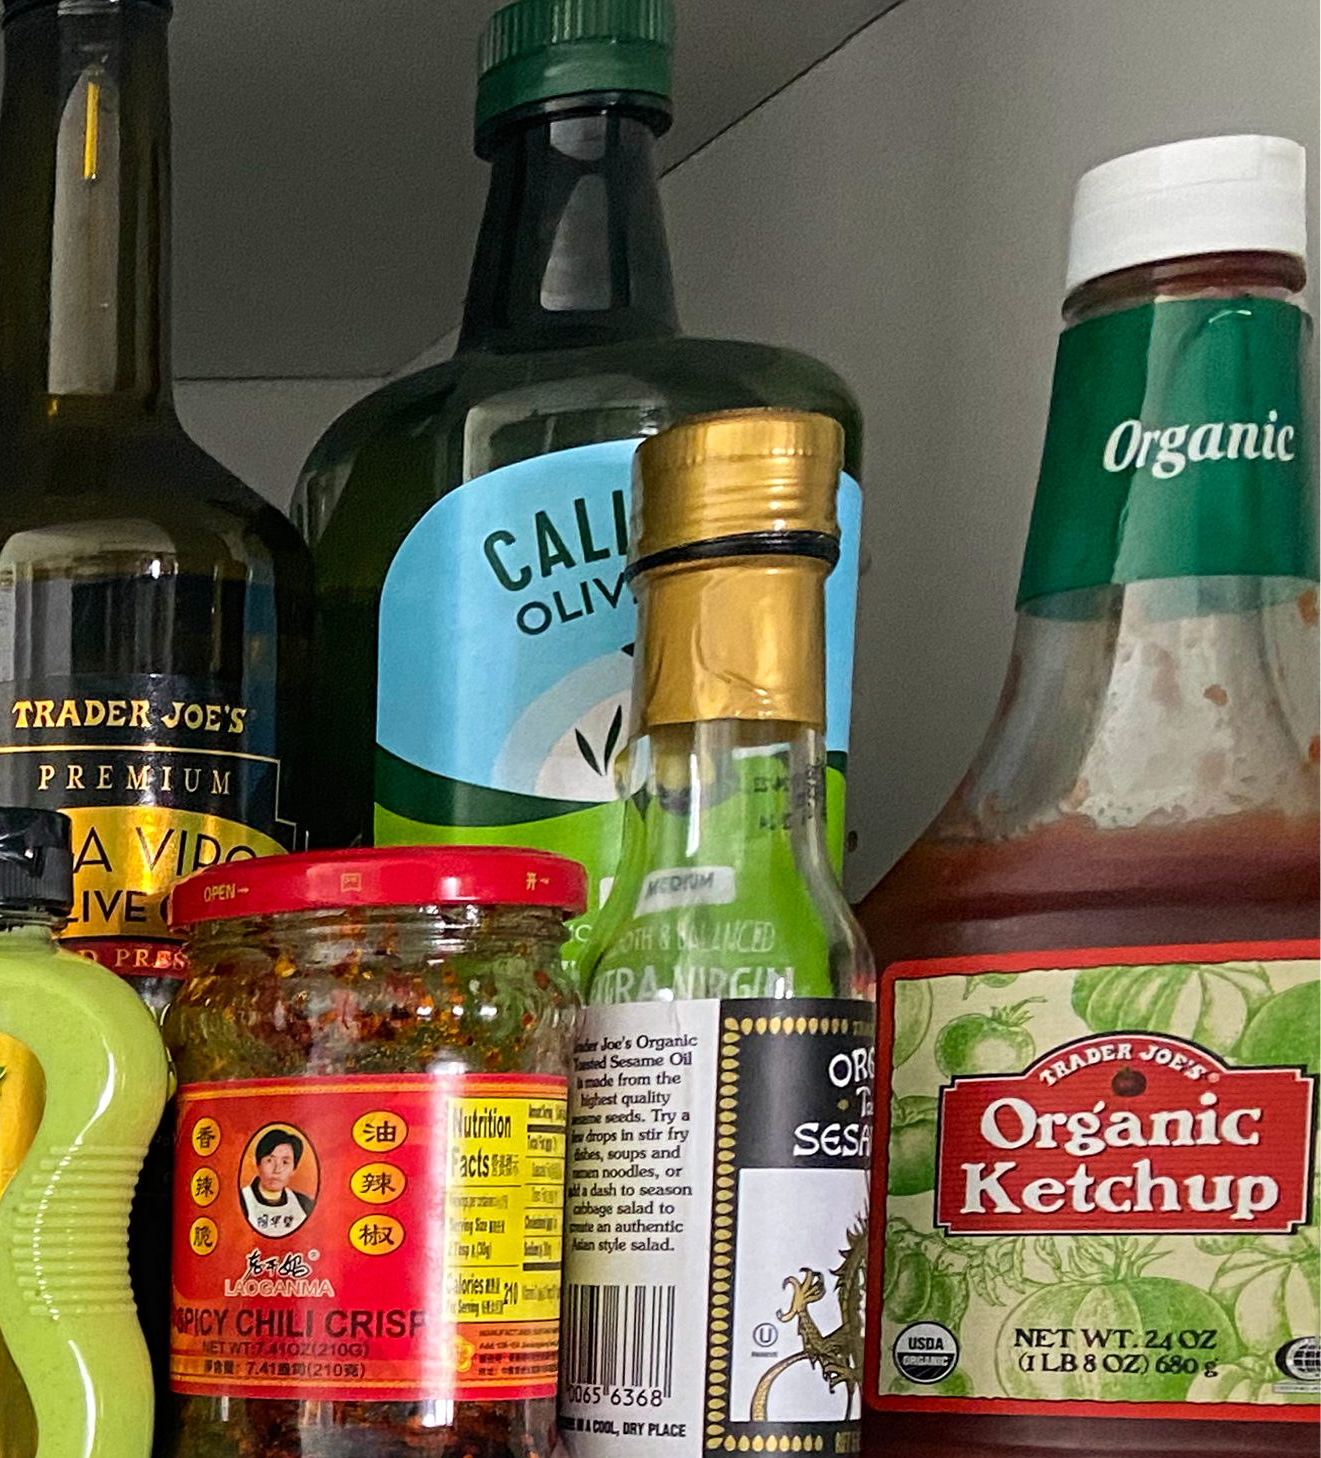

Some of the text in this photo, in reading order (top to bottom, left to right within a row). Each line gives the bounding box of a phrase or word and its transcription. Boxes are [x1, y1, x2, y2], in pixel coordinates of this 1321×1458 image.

[1103, 410, 1294, 479] Organic
[12, 699, 247, 734] TRADER JOE'S
[37, 764, 231, 796] PREMIUM
[1039, 1043, 1206, 1088] TRADER JOE'S
[622, 1091, 671, 1107] quality
[638, 1128, 689, 1143] stir fry
[981, 1091, 1262, 1157] Organic
[960, 1160, 1279, 1220] Ketchup
[224, 1279, 334, 1298] LAOGANMA
[909, 1335, 944, 1351] USDA
[1014, 1328, 1217, 1350] NET WT. 24 OZ
[610, 1389, 664, 1408] 6368
